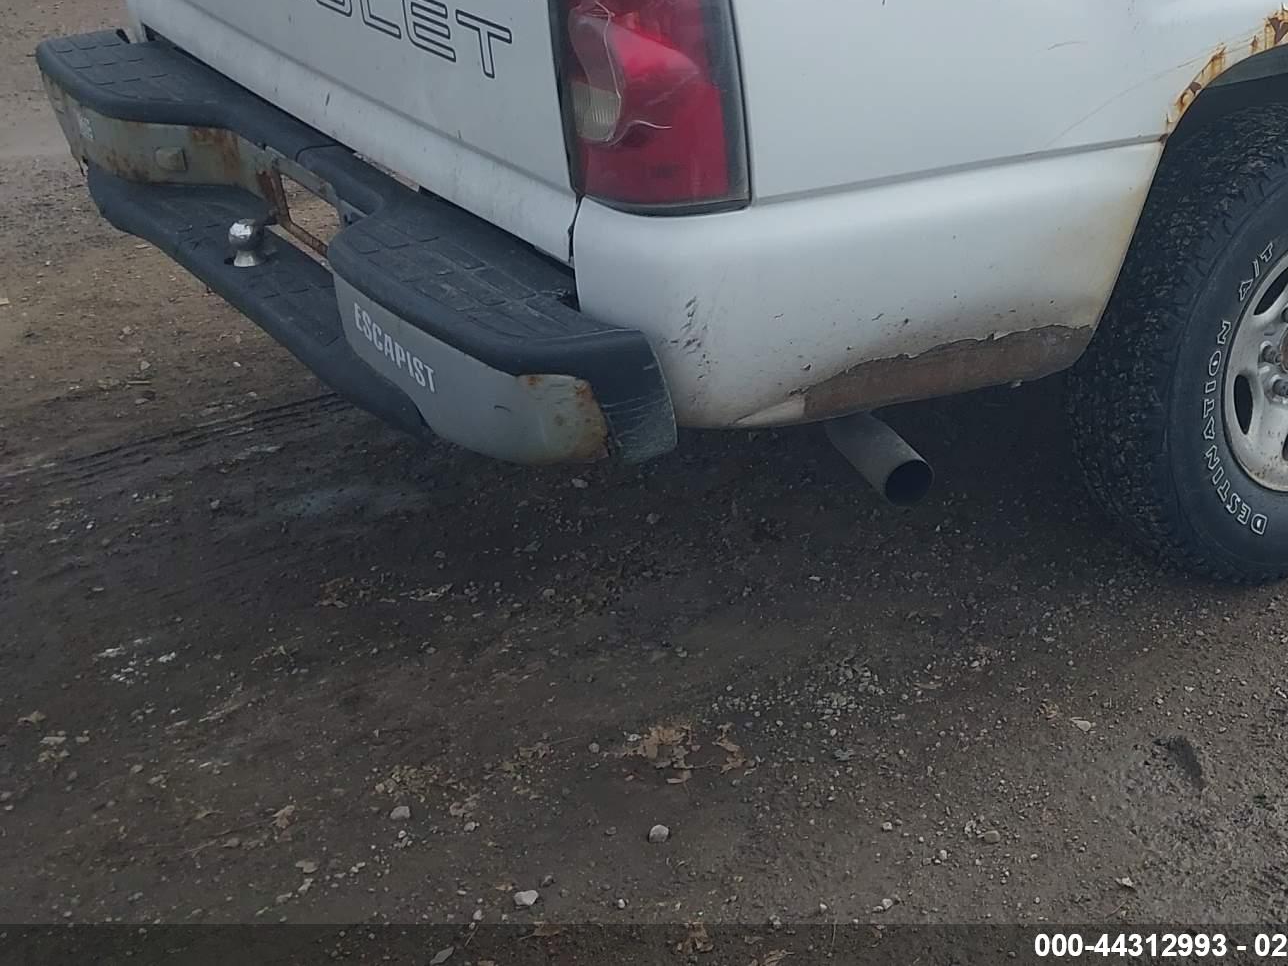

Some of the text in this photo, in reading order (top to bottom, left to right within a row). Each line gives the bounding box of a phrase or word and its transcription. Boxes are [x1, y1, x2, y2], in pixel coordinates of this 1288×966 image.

[353, 301, 435, 393] ESCAPIST
[1203, 241, 1274, 536] DESTINATION A/T
